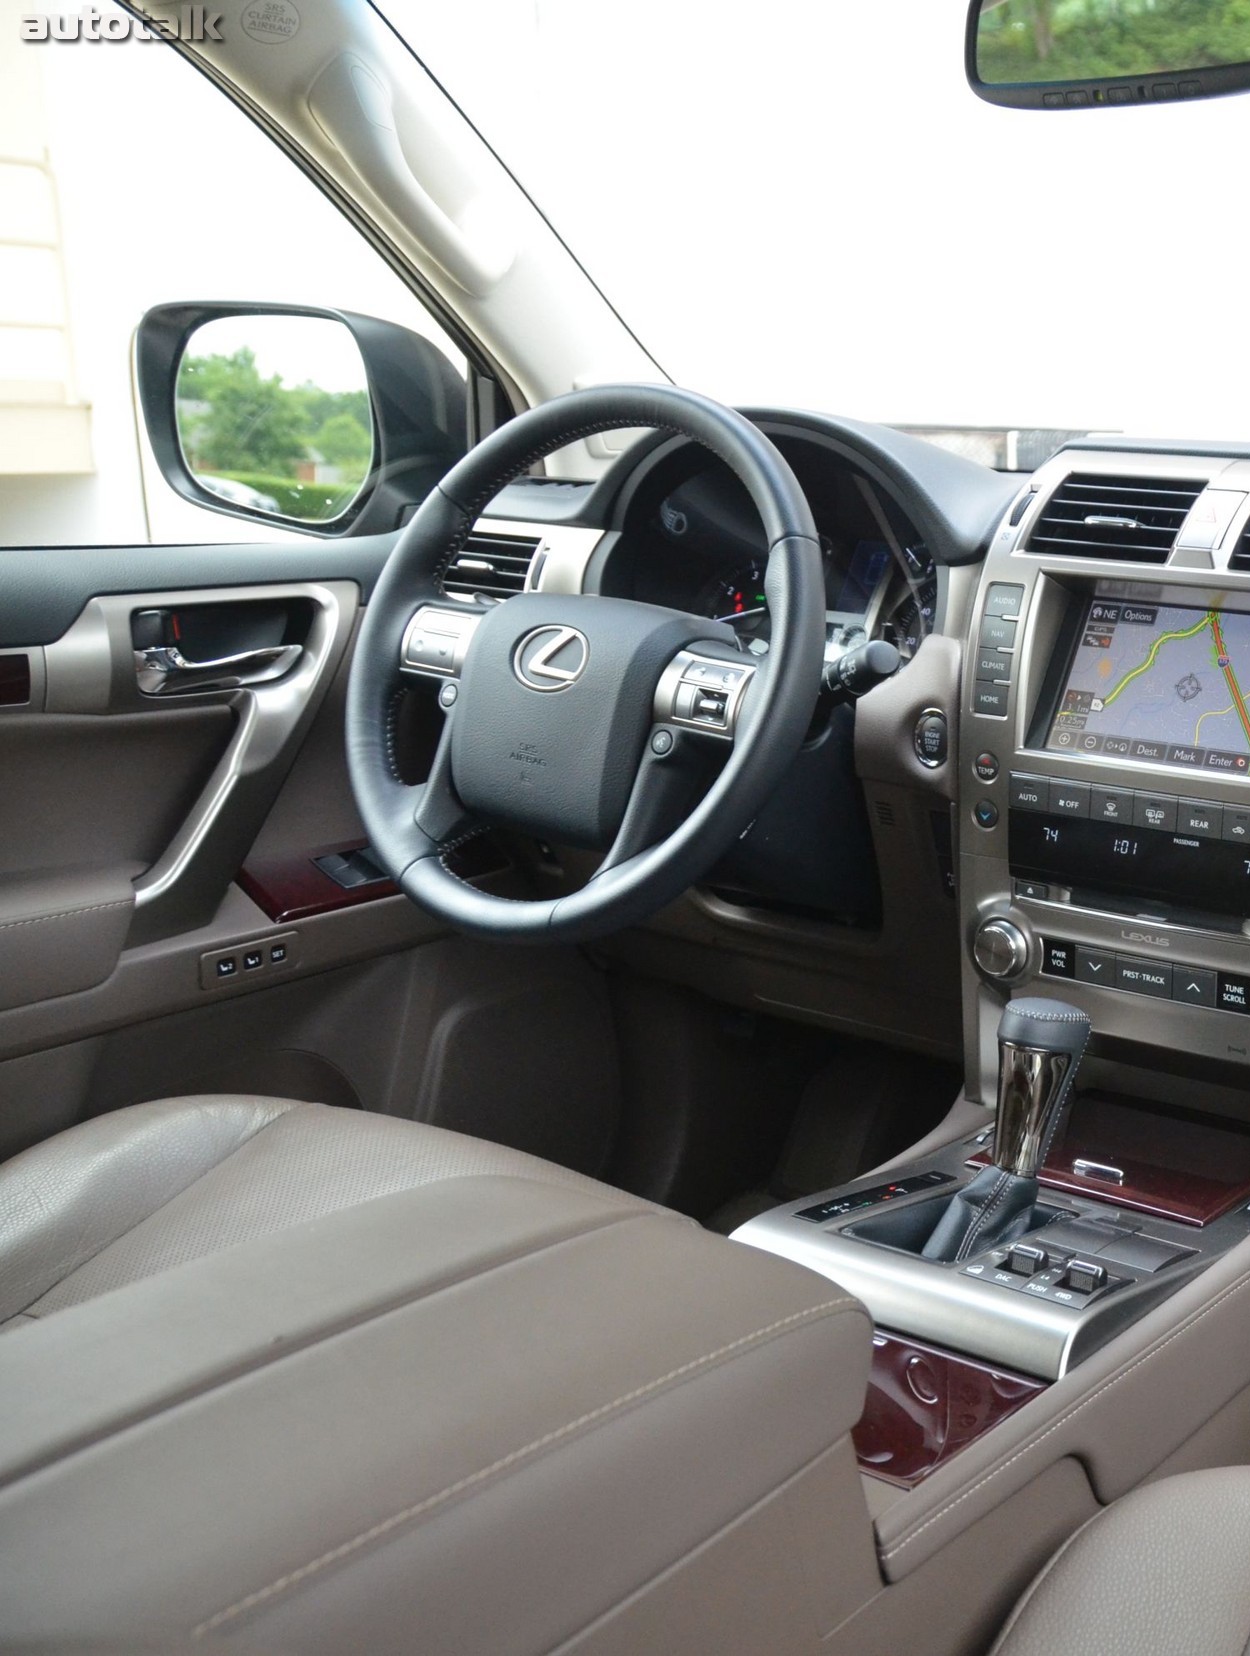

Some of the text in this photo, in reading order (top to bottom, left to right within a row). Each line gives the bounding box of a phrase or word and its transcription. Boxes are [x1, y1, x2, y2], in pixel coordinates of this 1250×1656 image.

[248, 10, 297, 26] CURTAIN
[249, 20, 292, 34] AIRBAG
[1103, 609, 1118, 620] NE
[1124, 609, 1152, 621] Options
[991, 630, 1005, 638] NAV
[981, 660, 1005, 671] CLIMATE
[980, 695, 999, 704] HOME
[1136, 744, 1159, 757] Dest.
[1174, 750, 1196, 762] Mark
[1208, 754, 1233, 767] Enter
[978, 766, 995, 775] TEMP
[1018, 793, 1038, 802] AUTO
[1065, 800, 1080, 809] OFF
[1189, 819, 1209, 829] REAR
[1043, 827, 1059, 842] 74
[1113, 839, 1138, 855] 1:01
[1172, 837, 1200, 848] PASSENGER
[1121, 930, 1170, 947] LEXUS
[271, 949, 285, 959] SET
[1051, 949, 1067, 959] PWR
[1051, 958, 1066, 968] VOL
[1224, 984, 1245, 995] TUNE
[1222, 993, 1247, 1005] SCROLL
[994, 1273, 1013, 1282] DAC
[1026, 1282, 1073, 1300] PUSH 4WD
